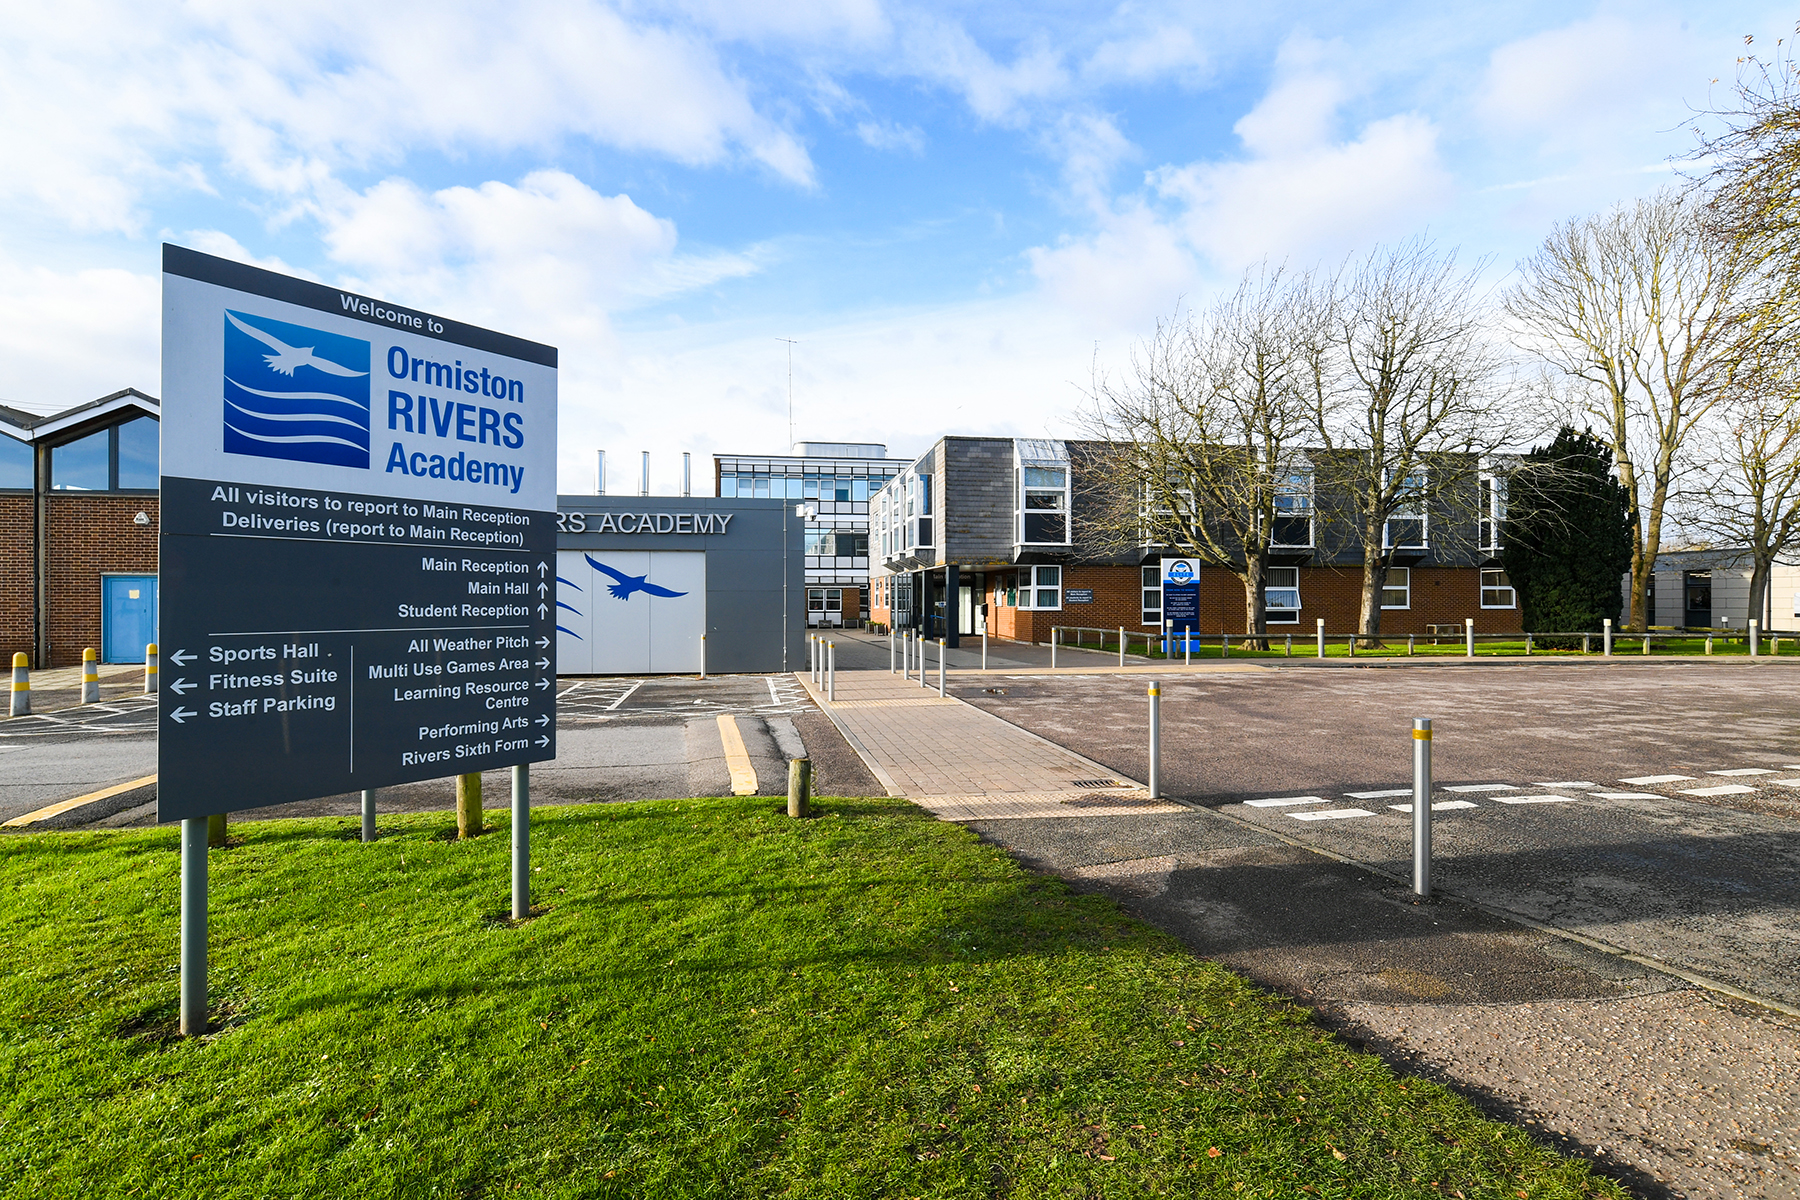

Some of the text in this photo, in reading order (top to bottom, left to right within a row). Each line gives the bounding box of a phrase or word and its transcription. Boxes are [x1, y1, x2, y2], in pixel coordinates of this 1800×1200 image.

[341, 293, 443, 334] Welcome to
[387, 345, 524, 403] Ormiston
[387, 389, 525, 449] RIVERS
[386, 442, 524, 494] Academy
[211, 486, 530, 526] All visitors to report to Main Reception
[222, 511, 524, 547] Deliveries (report to Main Reception)
[598, 512, 733, 535] ACADEMY
[422, 557, 529, 575] Main Reception
[468, 581, 529, 595] Main Hall
[398, 604, 529, 619] Student Reception
[209, 643, 319, 665] Sports Hall
[407, 635, 529, 653] All Weather Pitch
[209, 668, 338, 690] Fitness Suite
[368, 658, 529, 680] Multi Use Games Area
[395, 680, 529, 702] Learning Resource
[485, 695, 529, 710] Centre
[208, 694, 336, 718] Staff Parking
[419, 716, 529, 741] Performing Arts
[402, 738, 529, 766] Rivers Sixth Form
